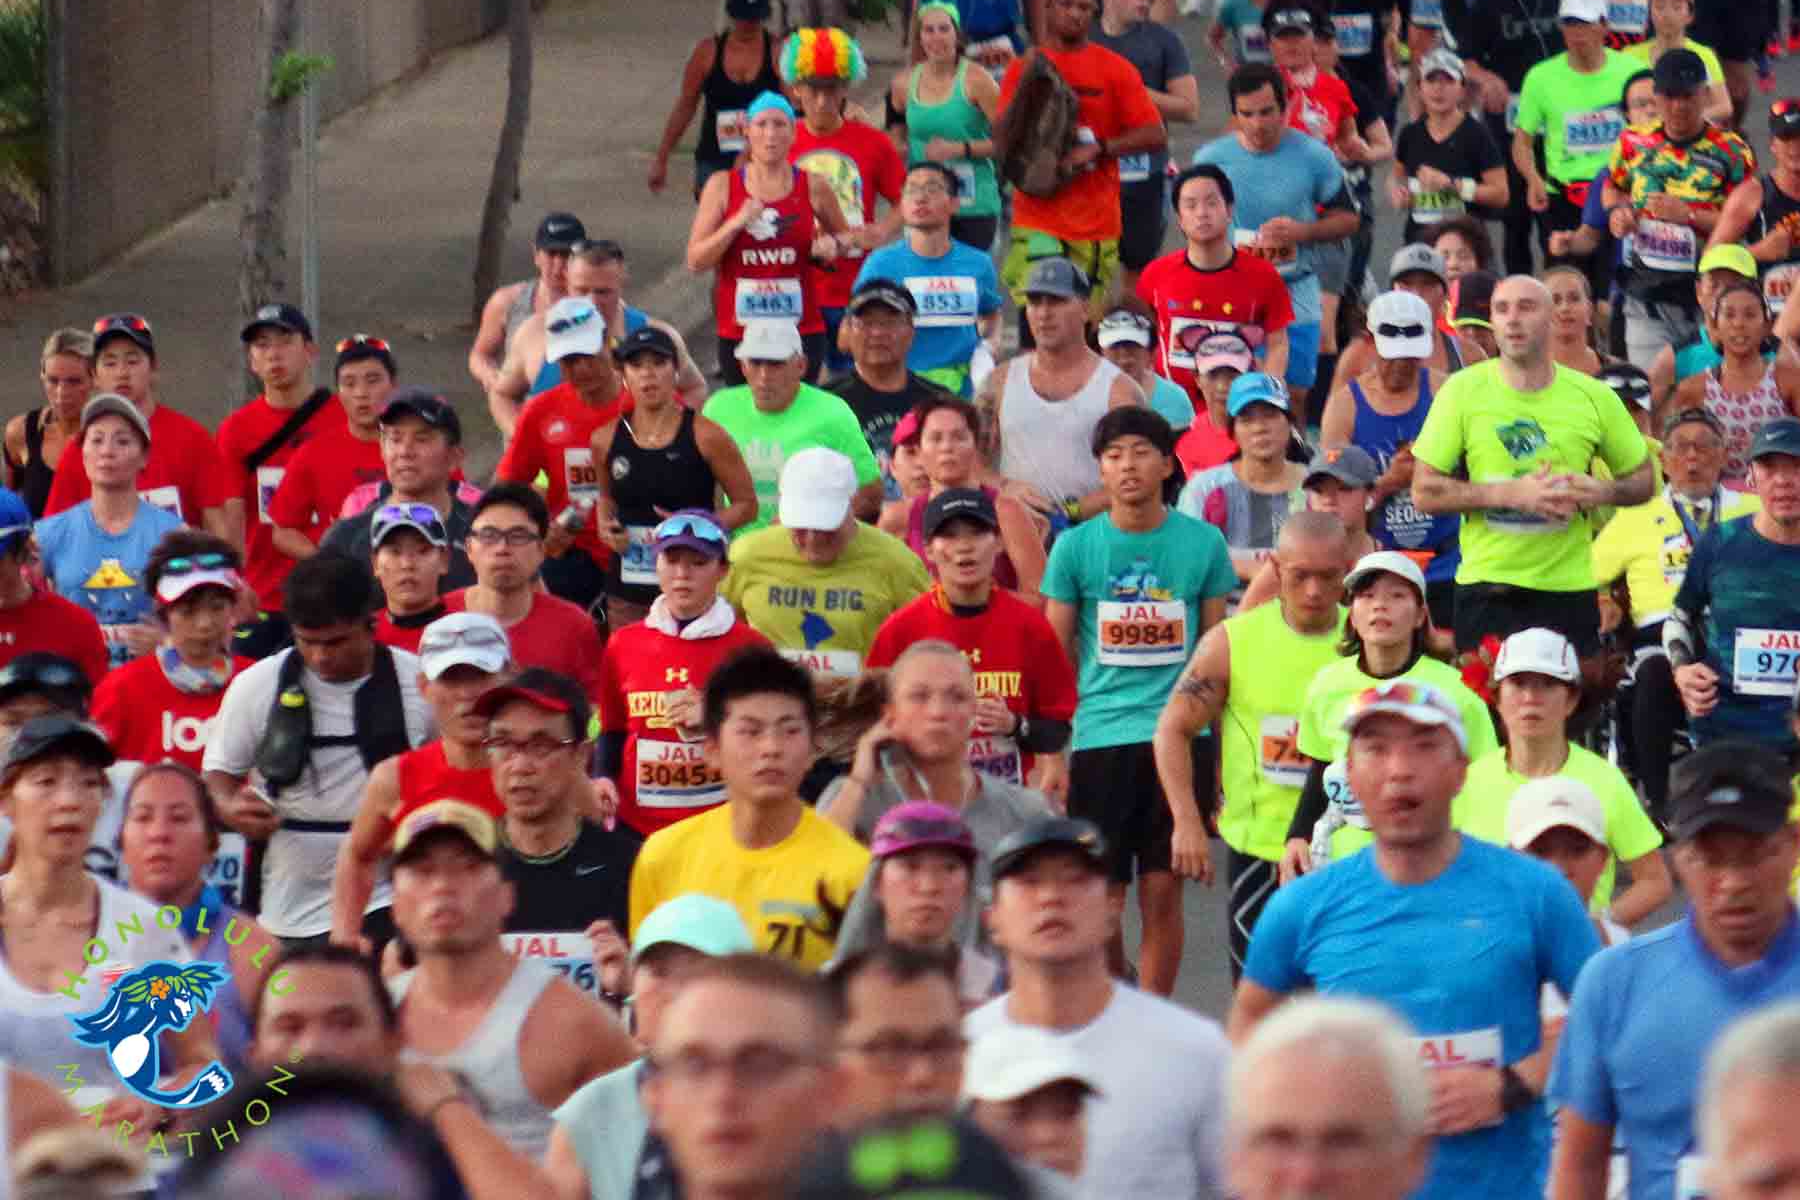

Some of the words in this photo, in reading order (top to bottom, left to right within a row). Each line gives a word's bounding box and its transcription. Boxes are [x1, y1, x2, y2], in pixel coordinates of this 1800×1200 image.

[742, 248, 796, 266] RWB
[769, 585, 815, 610] RUN
[824, 587, 865, 611] BIG
[1119, 606, 1162, 623] JAL
[1108, 624, 1177, 647] 9984
[657, 746, 702, 762] JAL
[508, 938, 568, 959] JAL
[1420, 1040, 1467, 1064] AL
